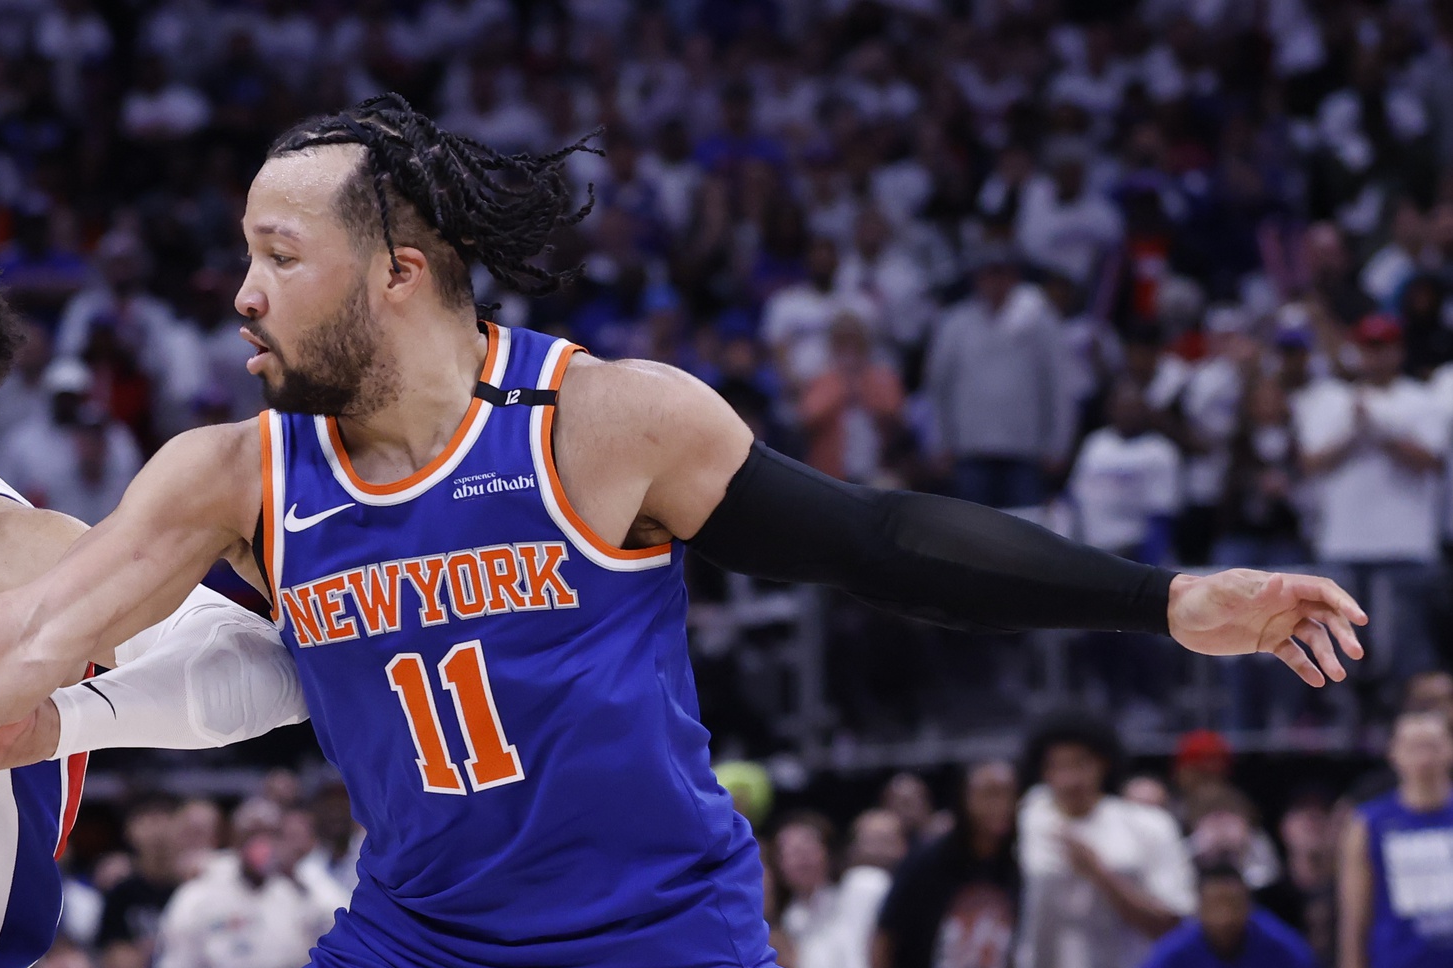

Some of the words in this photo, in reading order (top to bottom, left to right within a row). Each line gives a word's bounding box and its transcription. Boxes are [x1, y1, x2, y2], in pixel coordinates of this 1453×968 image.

[505, 389, 521, 405] 12
[452, 484, 484, 499] abu
[487, 474, 535, 493] dhabi
[453, 472, 496, 485] experience
[279, 559, 402, 648] NEW
[404, 541, 580, 628] YORK
[384, 639, 526, 796] 11
